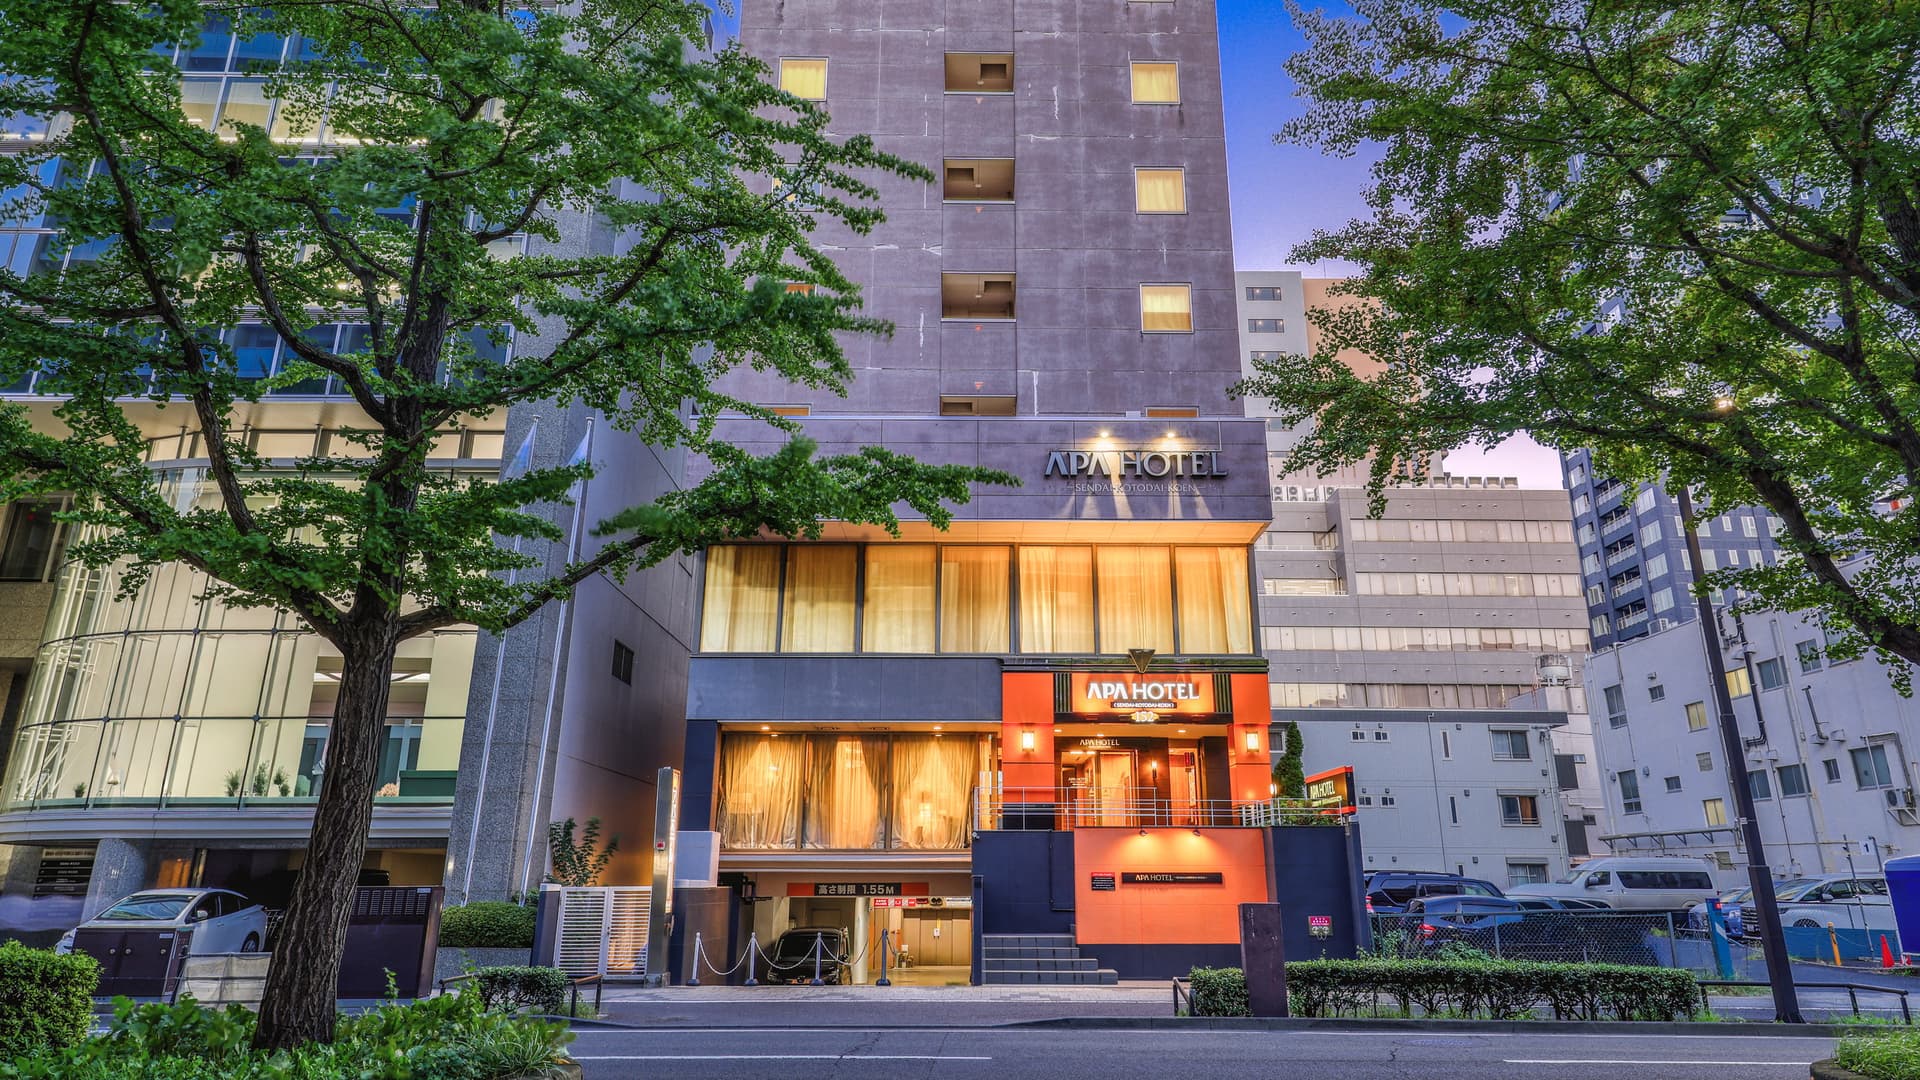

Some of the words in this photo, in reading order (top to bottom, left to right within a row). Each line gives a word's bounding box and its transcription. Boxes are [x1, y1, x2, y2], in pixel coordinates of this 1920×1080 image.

[1044, 450, 1112, 477] APA
[1118, 450, 1229, 478] HOTEL
[1087, 683, 1129, 700] APA
[1132, 683, 1200, 700] HOTEL
[818, 884, 857, 895] 高さ制限
